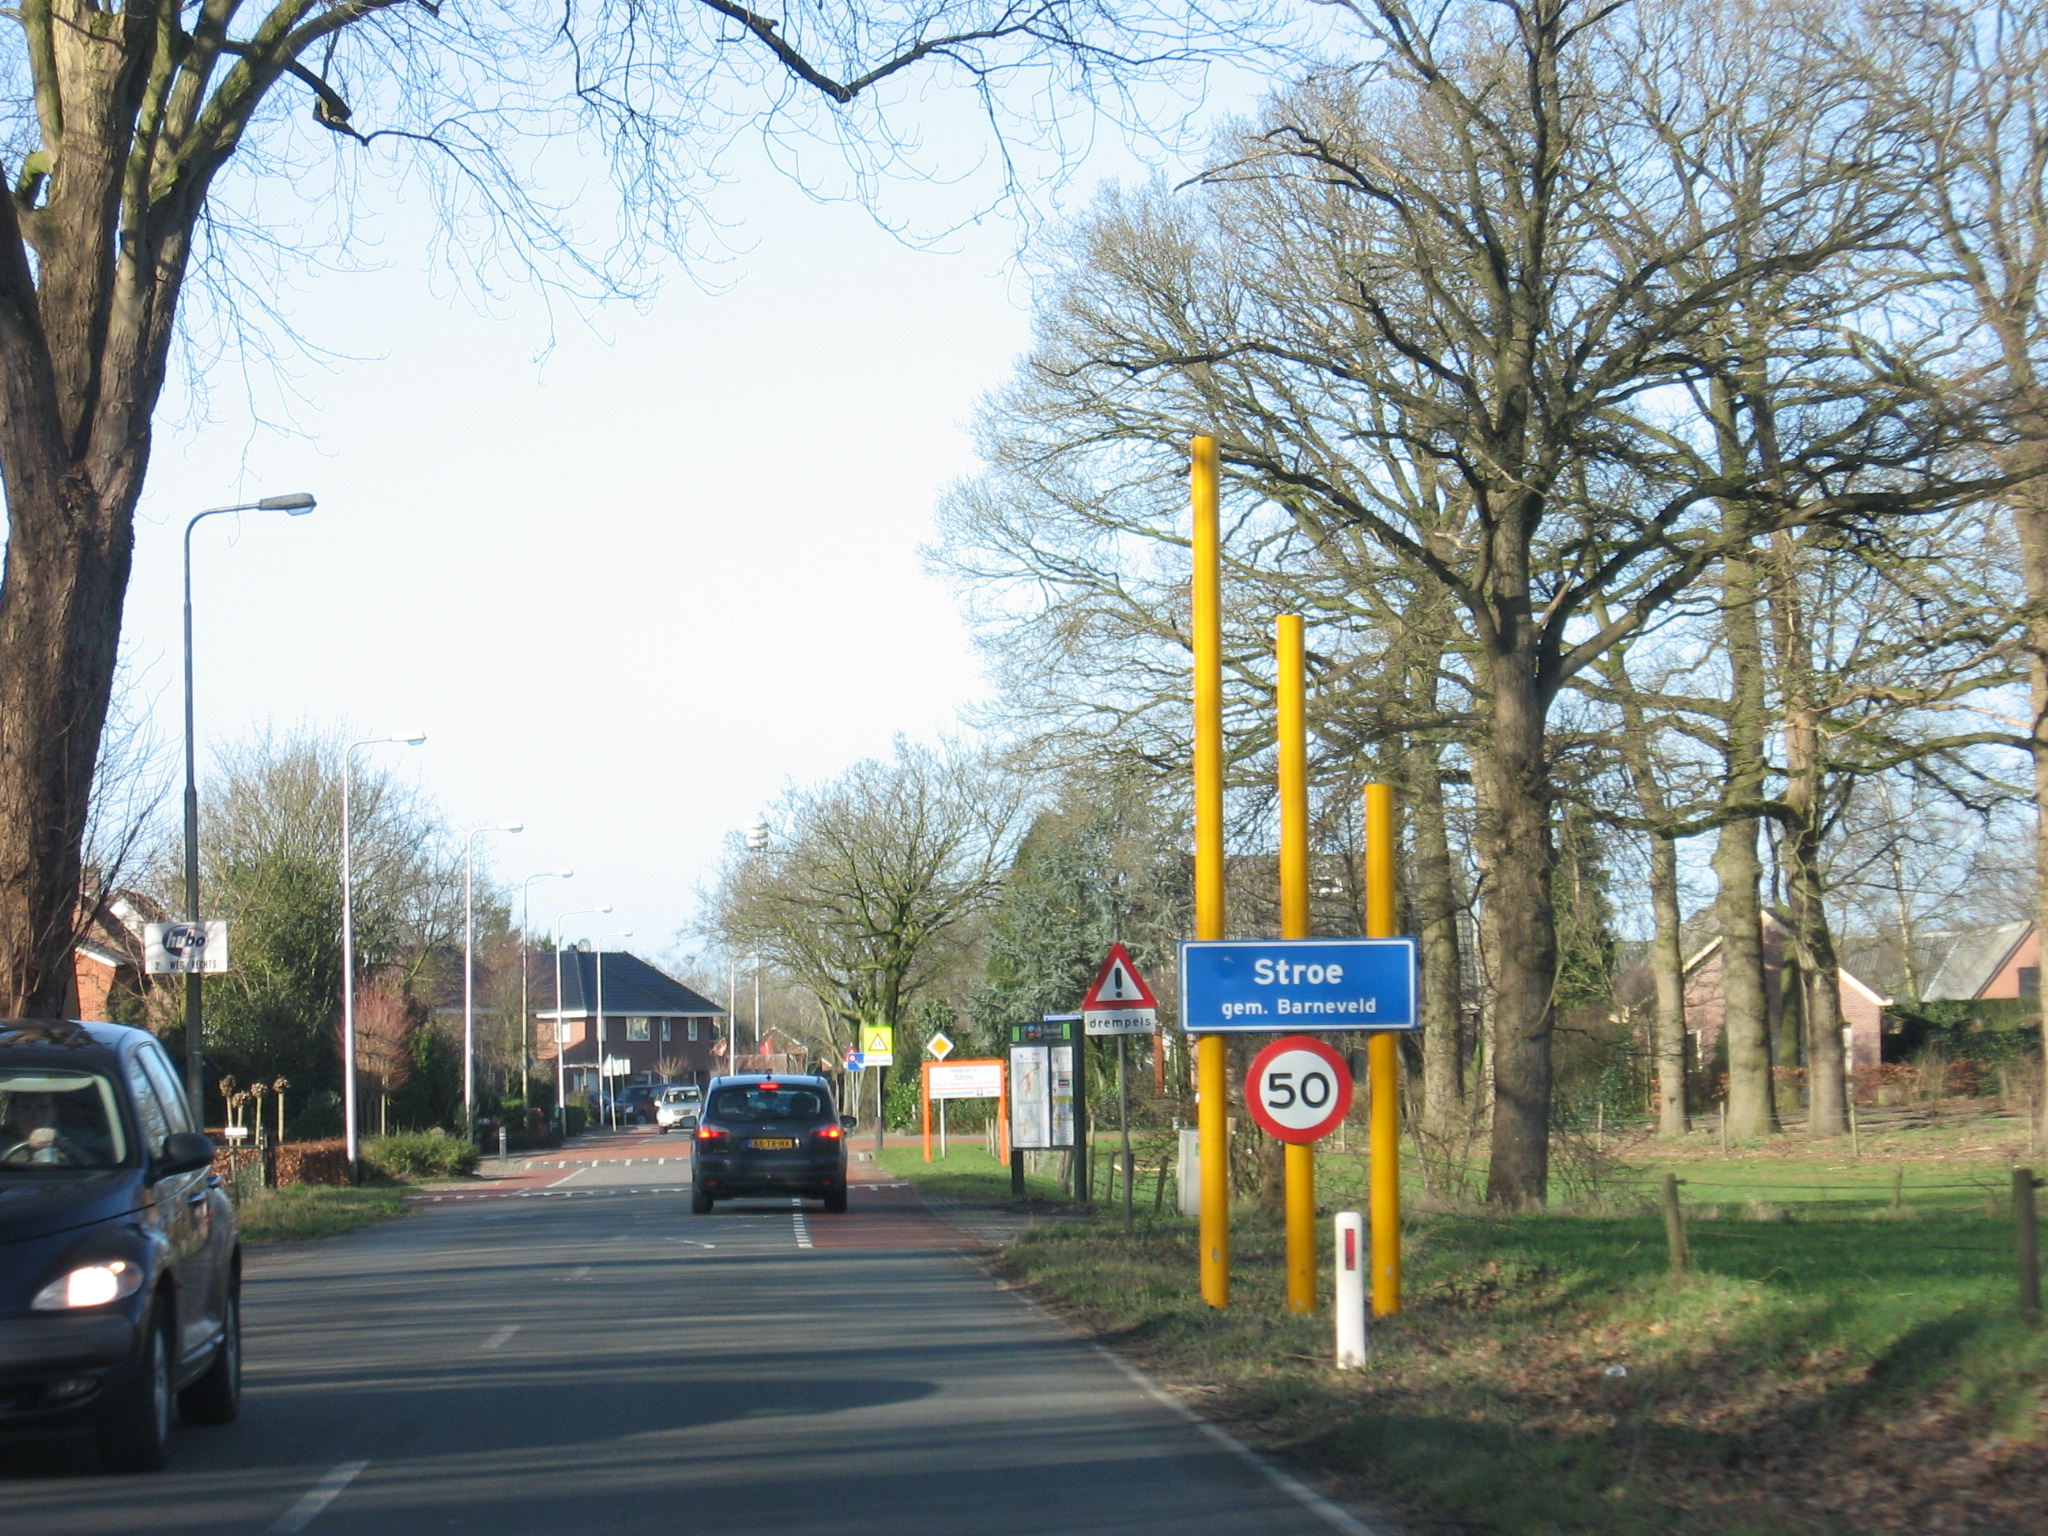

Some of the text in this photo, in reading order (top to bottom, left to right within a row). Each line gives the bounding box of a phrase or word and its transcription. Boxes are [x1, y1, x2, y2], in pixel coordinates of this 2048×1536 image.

[169, 960, 185, 970] WEG
[191, 960, 217, 969] RECHTS
[1254, 959, 1344, 985] Stroe
[1222, 998, 1377, 1019] gem. Barneveld
[1089, 1017, 1152, 1029] drempels
[1268, 1072, 1330, 1109] 50
